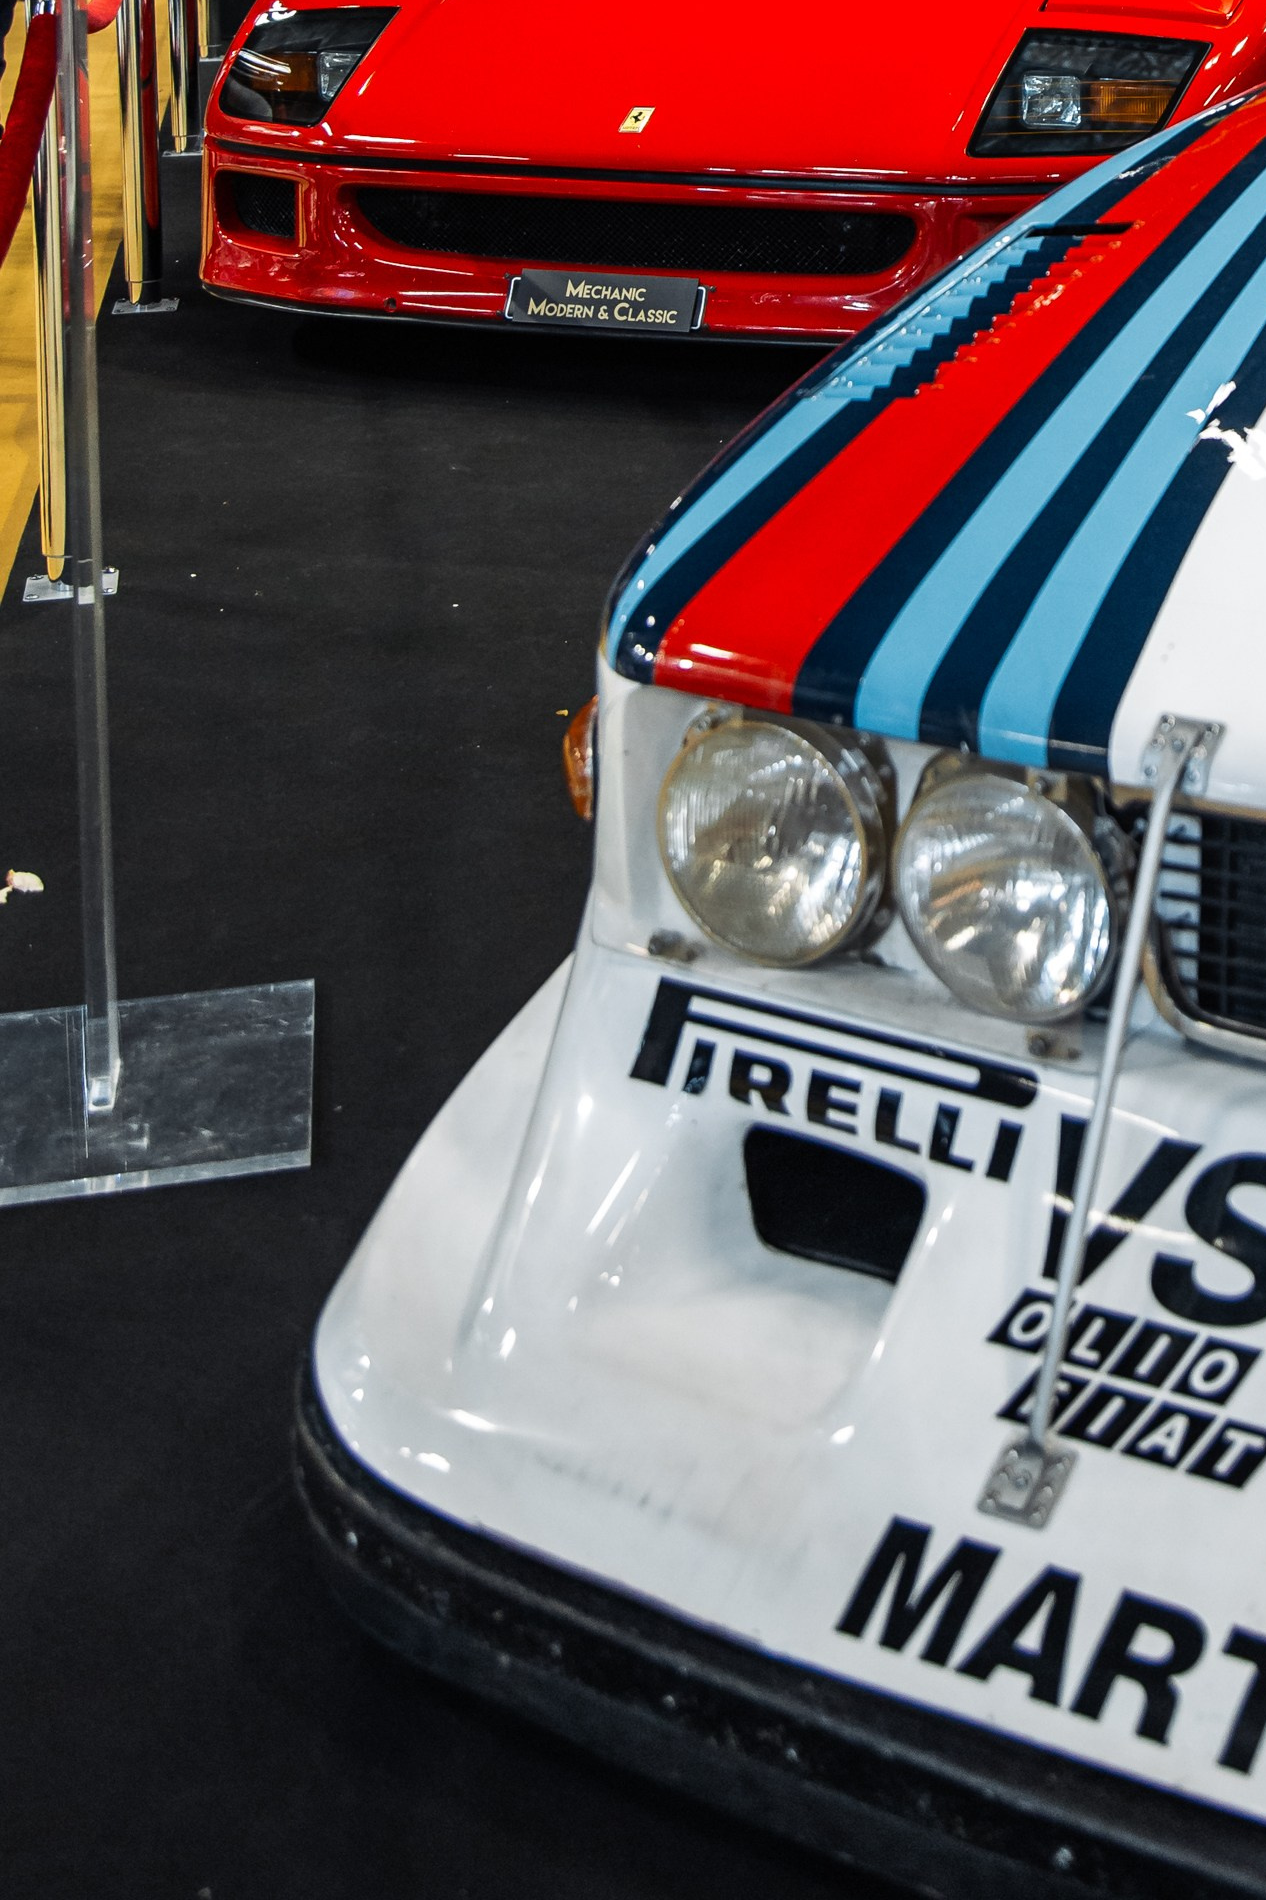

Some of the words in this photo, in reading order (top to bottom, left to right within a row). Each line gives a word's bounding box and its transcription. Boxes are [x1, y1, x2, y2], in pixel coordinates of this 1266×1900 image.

[527, 297, 594, 319] MODERN
[598, 306, 609, 320] &
[614, 302, 678, 325] CLASSIC
[565, 278, 647, 302] MECHANIC
[629, 976, 1039, 1183] PIRELLI
[1002, 1294, 1247, 1399] OLIO
